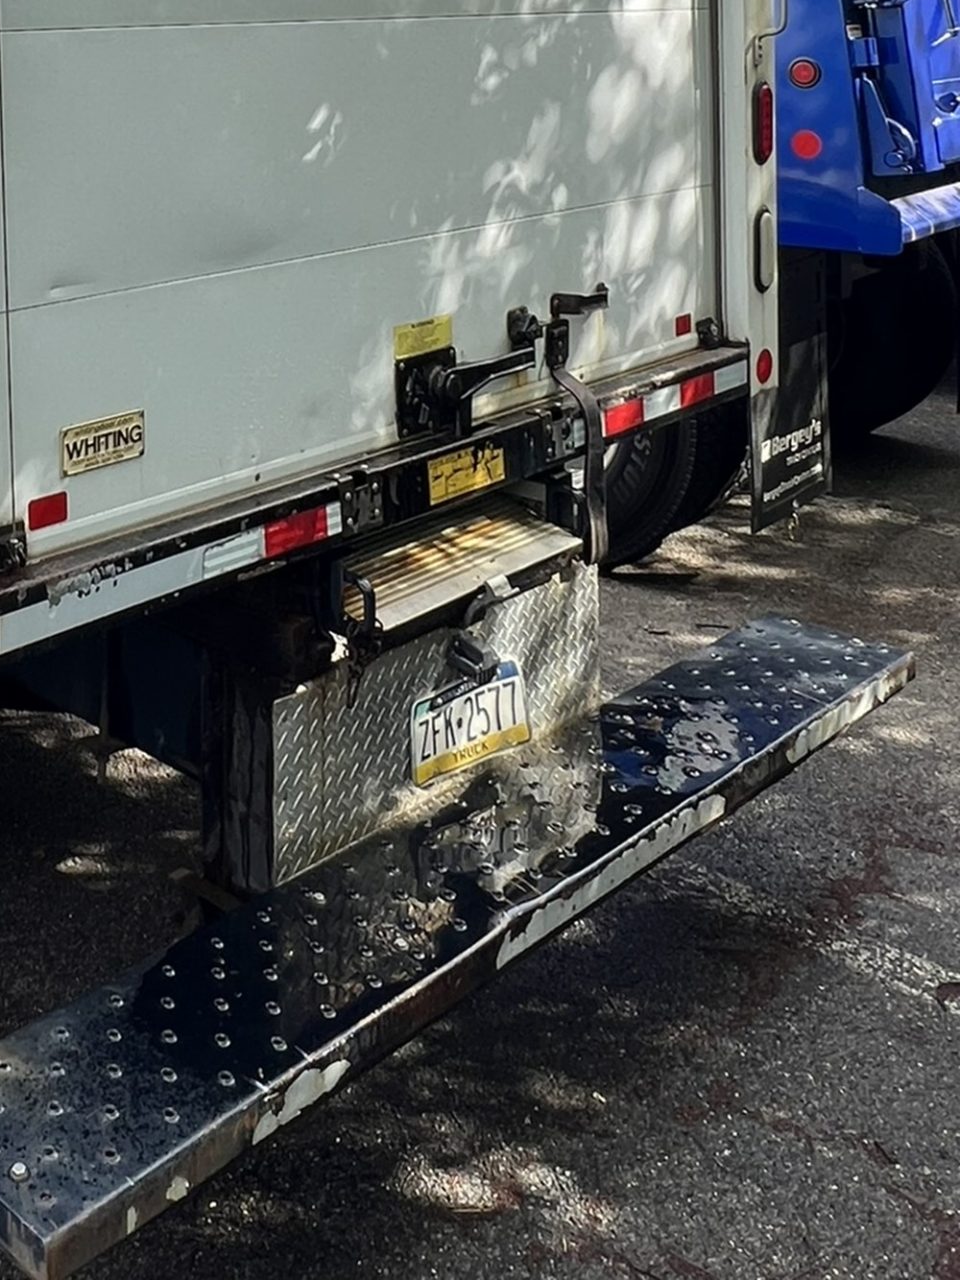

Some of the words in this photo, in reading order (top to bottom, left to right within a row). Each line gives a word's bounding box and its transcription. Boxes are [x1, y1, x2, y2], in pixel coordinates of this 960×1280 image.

[65, 424, 143, 461] WHITING
[771, 418, 822, 457] Bergey's
[452, 742, 490, 764] TRUCK
